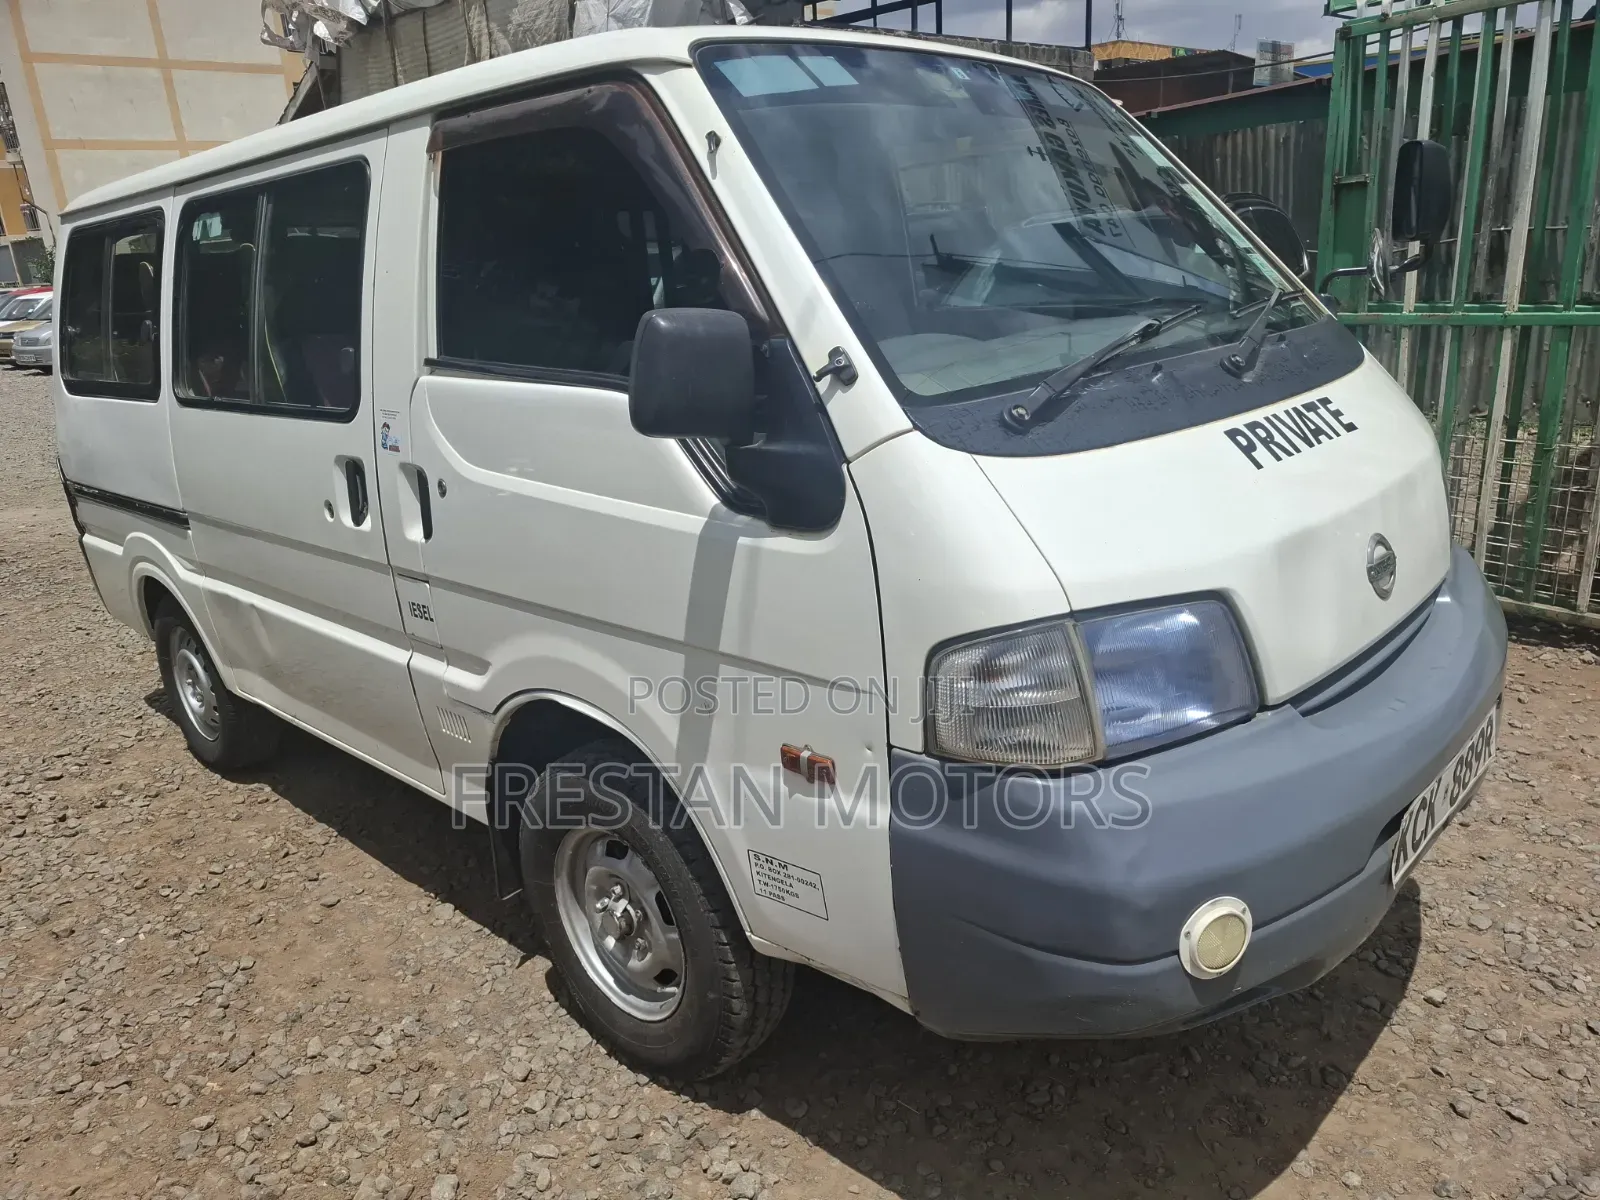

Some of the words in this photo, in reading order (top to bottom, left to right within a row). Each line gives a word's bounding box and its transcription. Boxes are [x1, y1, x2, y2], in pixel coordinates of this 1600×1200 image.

[1223, 396, 1359, 470] PRIVATE
[408, 601, 434, 623] IESEL
[1394, 777, 1442, 877] KCK
[1449, 714, 1494, 808] 889R
[753, 853, 789, 872] S.N.M
[754, 861, 767, 871] P.O.
[768, 866, 782, 876] BOX
[756, 870, 794, 889] KITENGELA
[759, 888, 767, 896] 11
[768, 890, 786, 902] PASS
